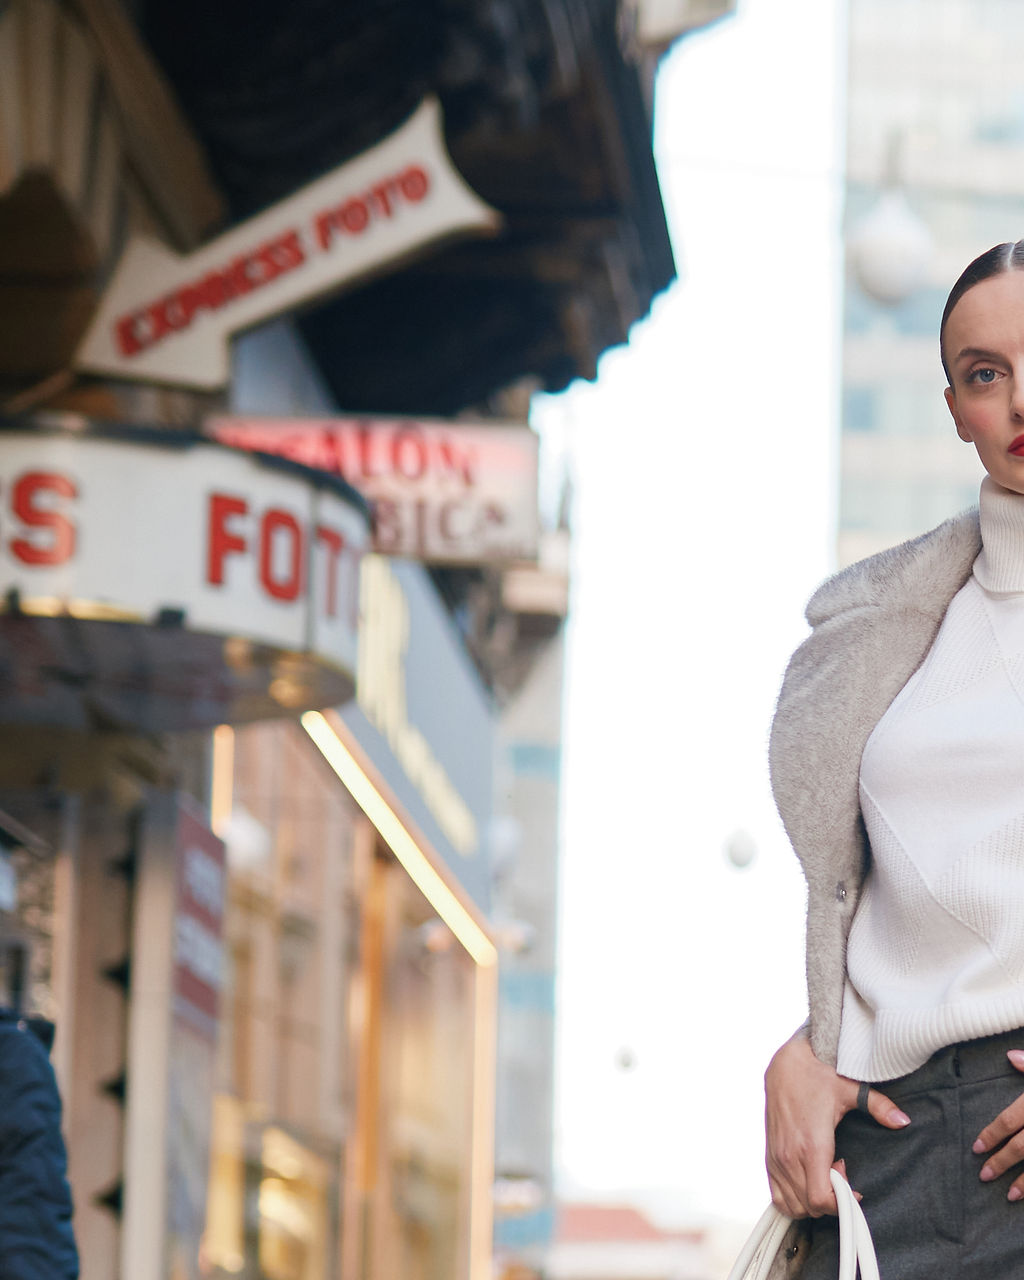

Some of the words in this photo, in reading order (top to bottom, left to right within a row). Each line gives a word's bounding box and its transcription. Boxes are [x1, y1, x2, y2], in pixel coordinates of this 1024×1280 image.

[115, 230, 306, 356] EXPRESS
[313, 164, 431, 252] FOTO
[6, 469, 79, 569] S
